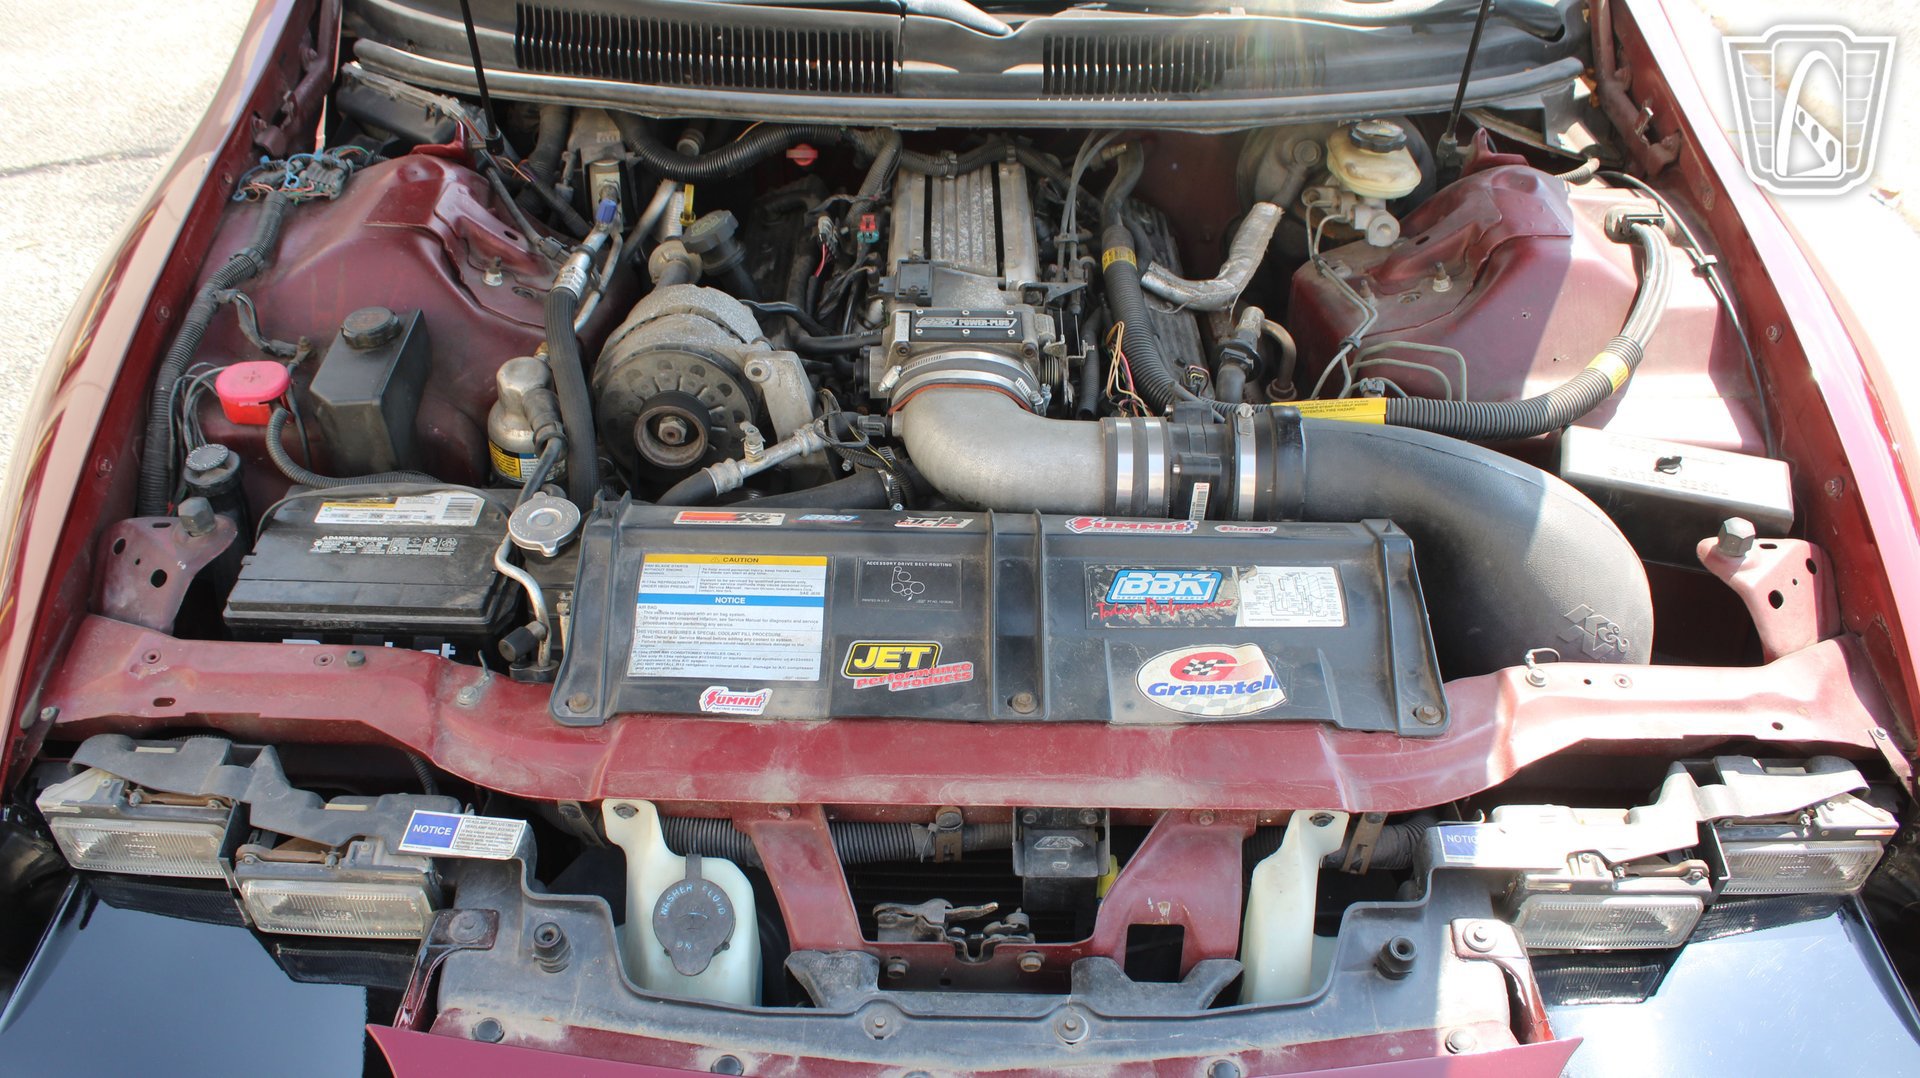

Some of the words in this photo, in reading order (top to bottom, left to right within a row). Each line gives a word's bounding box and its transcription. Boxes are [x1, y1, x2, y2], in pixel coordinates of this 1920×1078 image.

[1120, 572, 1213, 595] BBK
[1096, 602, 1143, 620] Today's
[1144, 598, 1232, 616] Performance
[854, 646, 932, 670] JET
[1148, 675, 1279, 696] Granatell
[412, 824, 452, 836] NOTICE
[1446, 834, 1479, 844] NOTIC
[702, 885, 727, 915] FLUID
